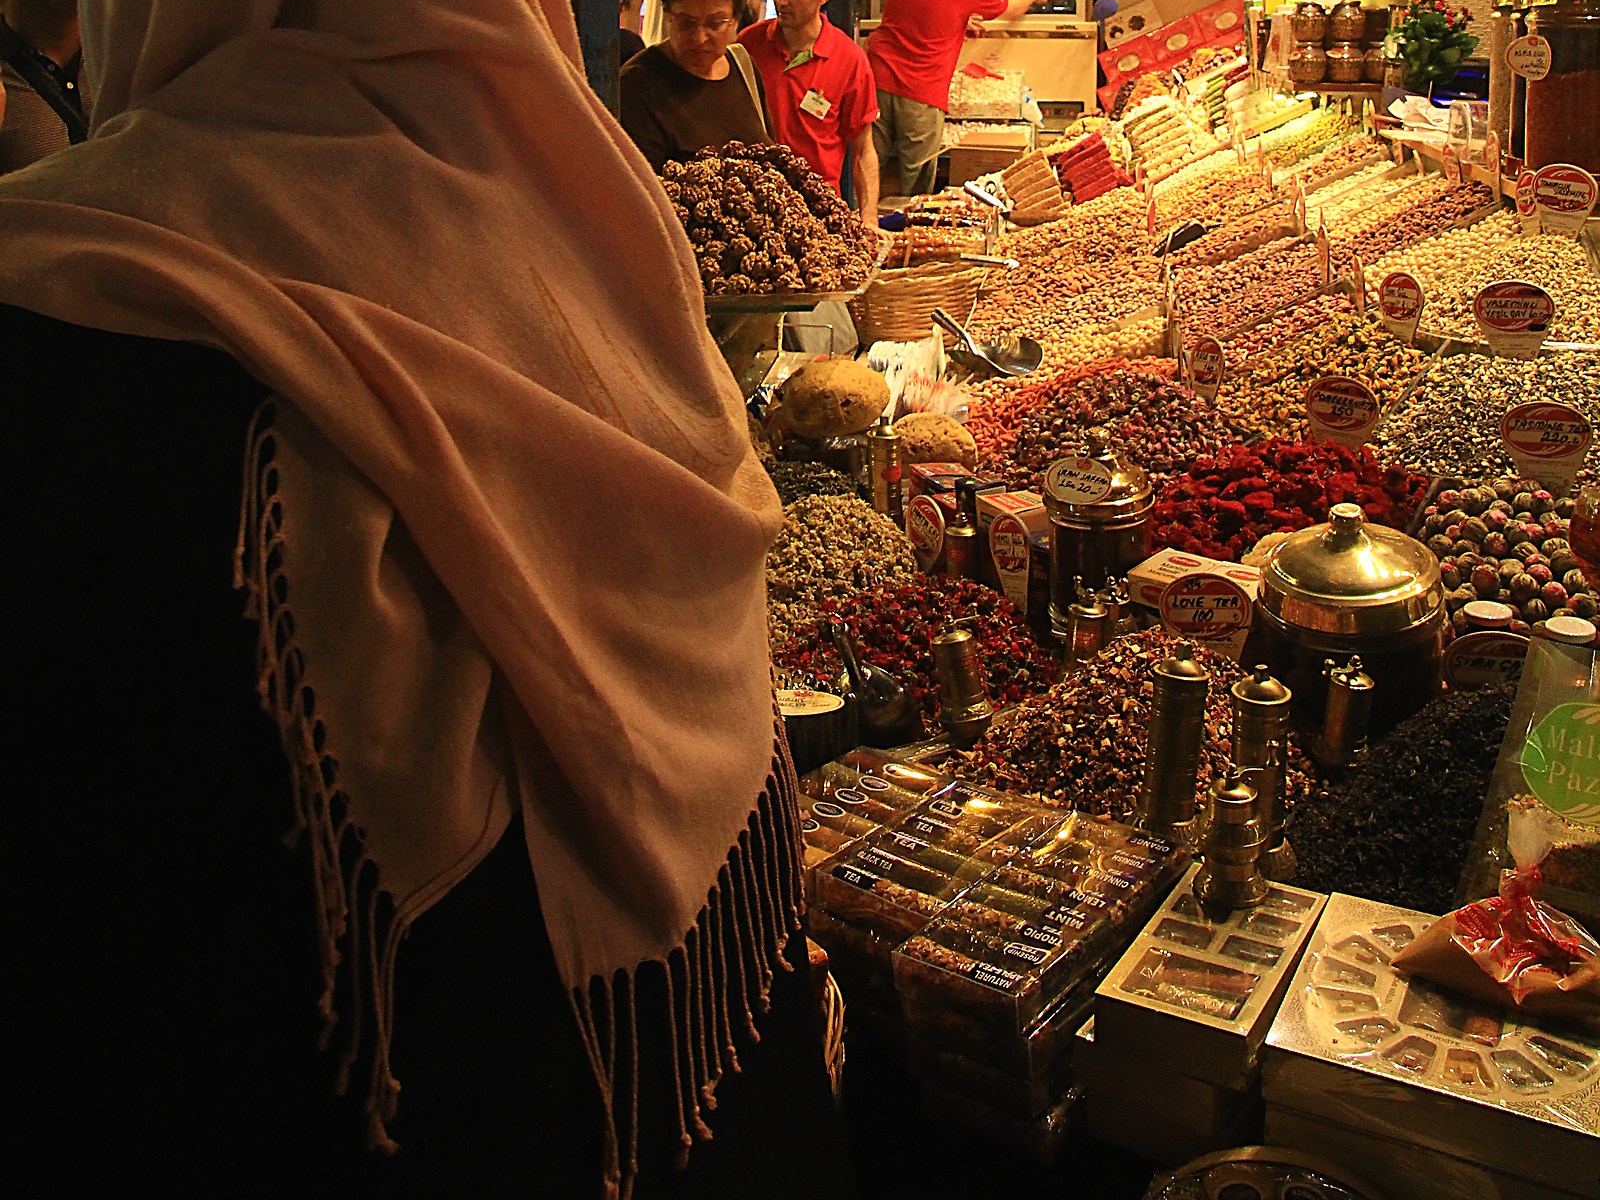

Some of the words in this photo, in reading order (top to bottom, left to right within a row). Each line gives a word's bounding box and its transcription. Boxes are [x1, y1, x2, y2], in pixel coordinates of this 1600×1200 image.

[1512, 420, 1564, 431] JASMINE
[1172, 594, 1205, 608] LOVE
[1212, 596, 1239, 608] TEA
[1192, 609, 1215, 623] 100
[1548, 725, 1600, 759] Mal
[916, 822, 934, 834] TEA
[893, 834, 917, 850] TEA
[1130, 838, 1170, 853] ORANGE
[857, 851, 880, 866] BLACK
[879, 858, 893, 871] TEA
[844, 871, 861, 884] TEA
[1069, 890, 1106, 908] LEMON
[1045, 910, 1085, 930] MINT
[1060, 905, 1087, 920] TEA
[1023, 928, 1064, 948] TROPIC
[1006, 948, 1040, 963] ROSEHIP
[974, 971, 1012, 989] NATUREL
